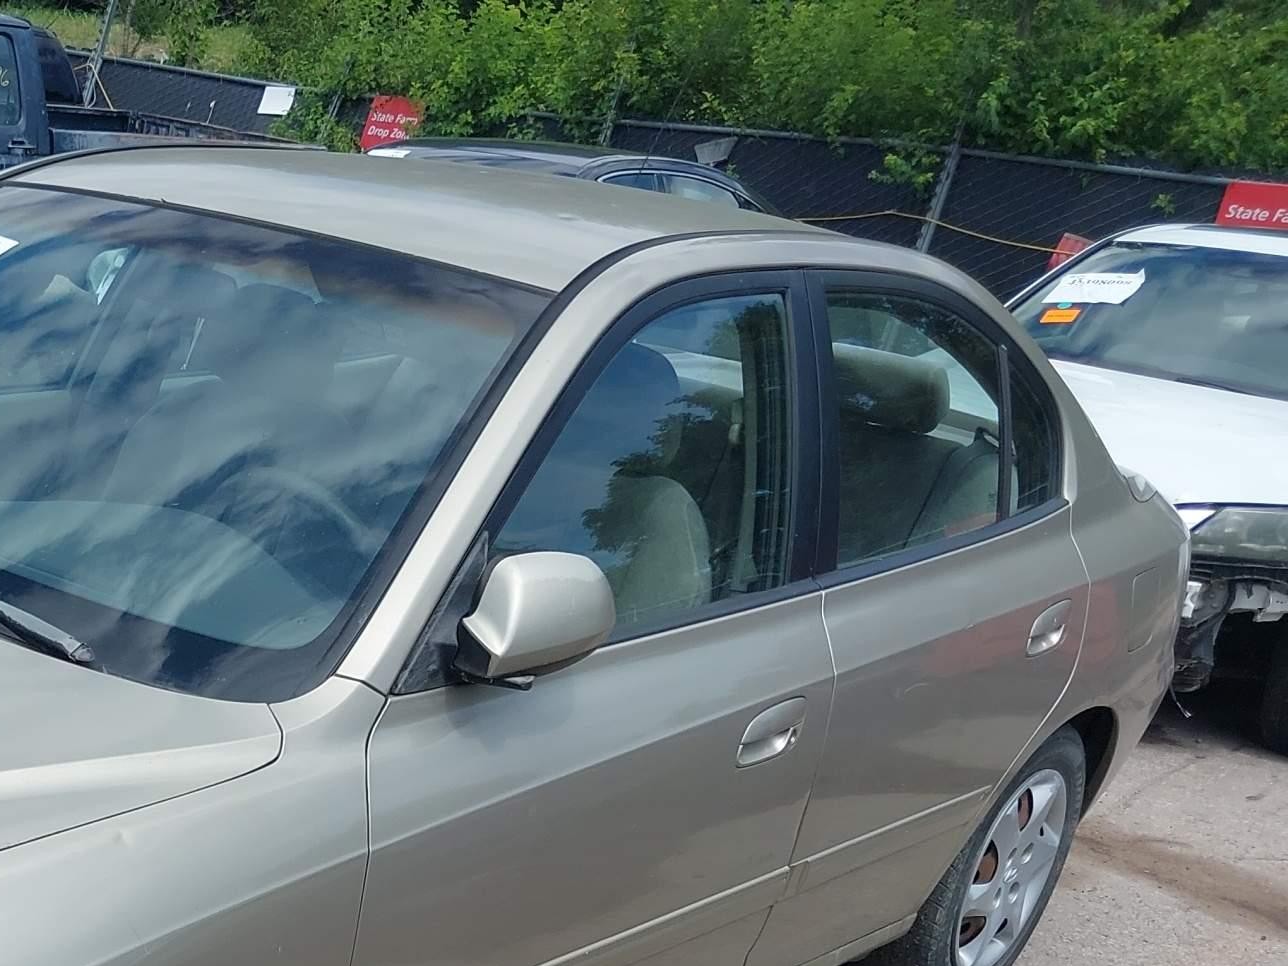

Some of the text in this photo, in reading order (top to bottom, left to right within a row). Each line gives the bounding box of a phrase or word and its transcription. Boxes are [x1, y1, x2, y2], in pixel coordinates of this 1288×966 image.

[371, 111, 394, 123] State
[367, 125, 389, 139] Drop
[1224, 204, 1270, 222] State
